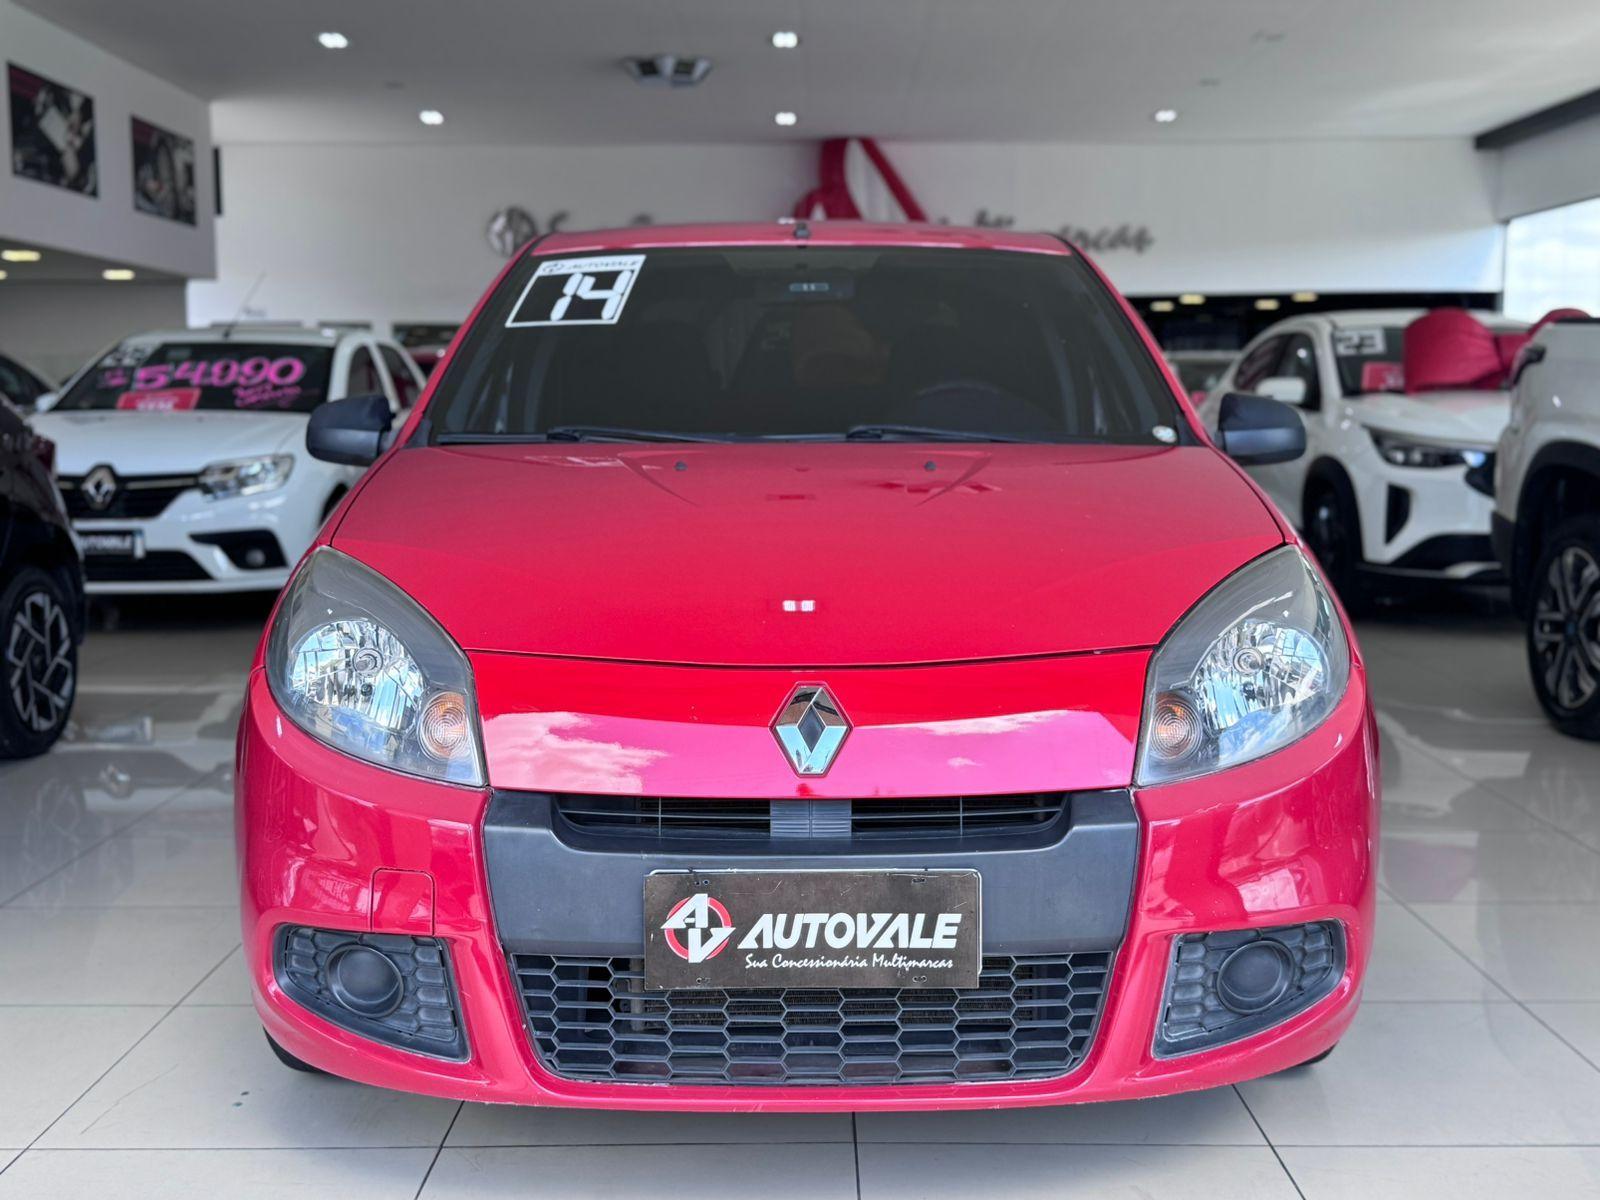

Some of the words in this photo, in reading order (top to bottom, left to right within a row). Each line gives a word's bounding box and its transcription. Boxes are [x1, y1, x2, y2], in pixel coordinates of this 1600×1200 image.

[551, 269, 633, 321] 14
[737, 912, 962, 950] AUTOVALE
[744, 952, 769, 969] Sua
[771, 952, 869, 969] Concessionária
[872, 952, 954, 972] Multimarcas
